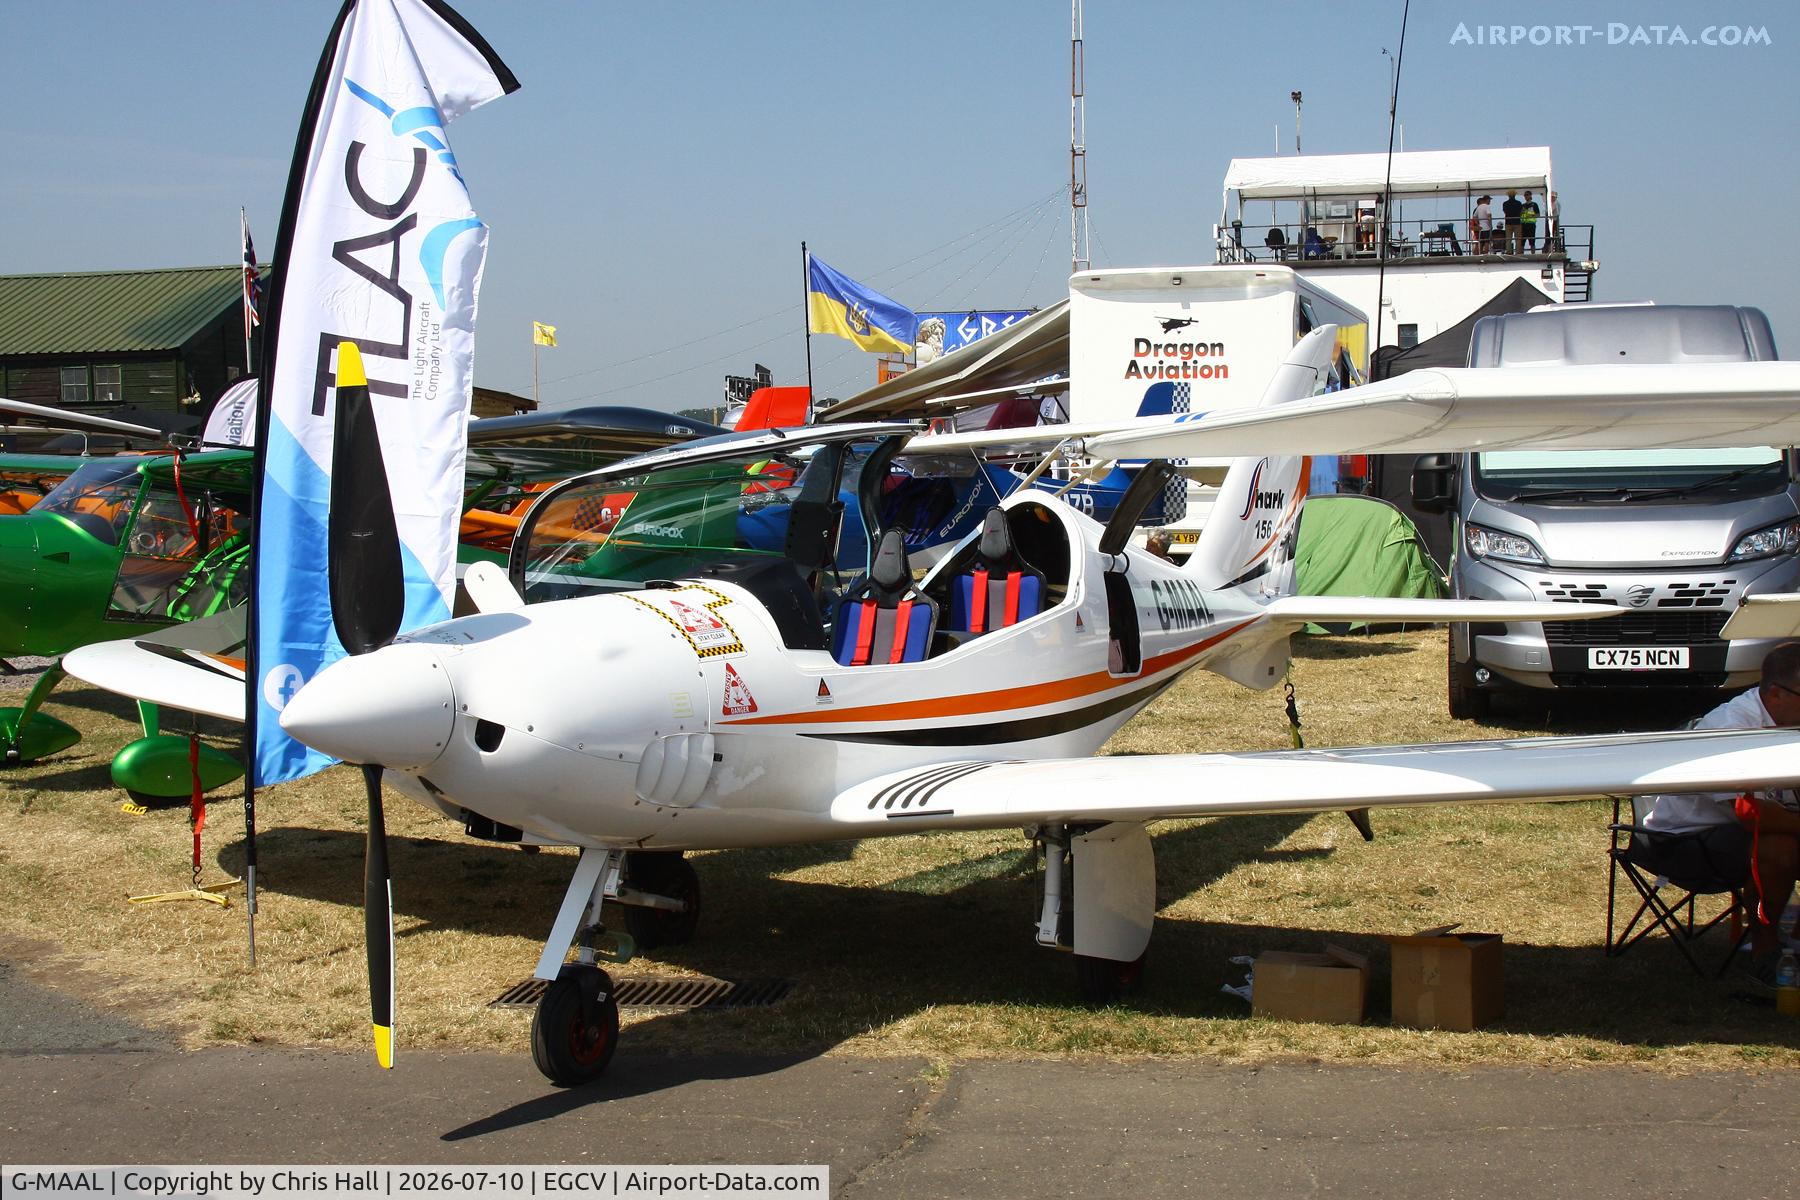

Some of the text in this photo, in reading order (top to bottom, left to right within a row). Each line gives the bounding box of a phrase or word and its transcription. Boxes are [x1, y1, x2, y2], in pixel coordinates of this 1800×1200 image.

[311, 140, 428, 416] TLAC
[413, 301, 430, 400] The Light Aircraft
[1134, 338, 1224, 360] Dragon
[425, 323, 442, 400] Company Ltd
[1124, 360, 1229, 379] Aviation
[940, 480, 984, 537] EUROFOX
[634, 523, 685, 539] EUROFOX
[1255, 520, 1272, 539] 156
[1151, 580, 1215, 632] G-MAAL
[1596, 650, 1680, 665] CX75 NCN
[730, 706, 750, 714] DANGER
